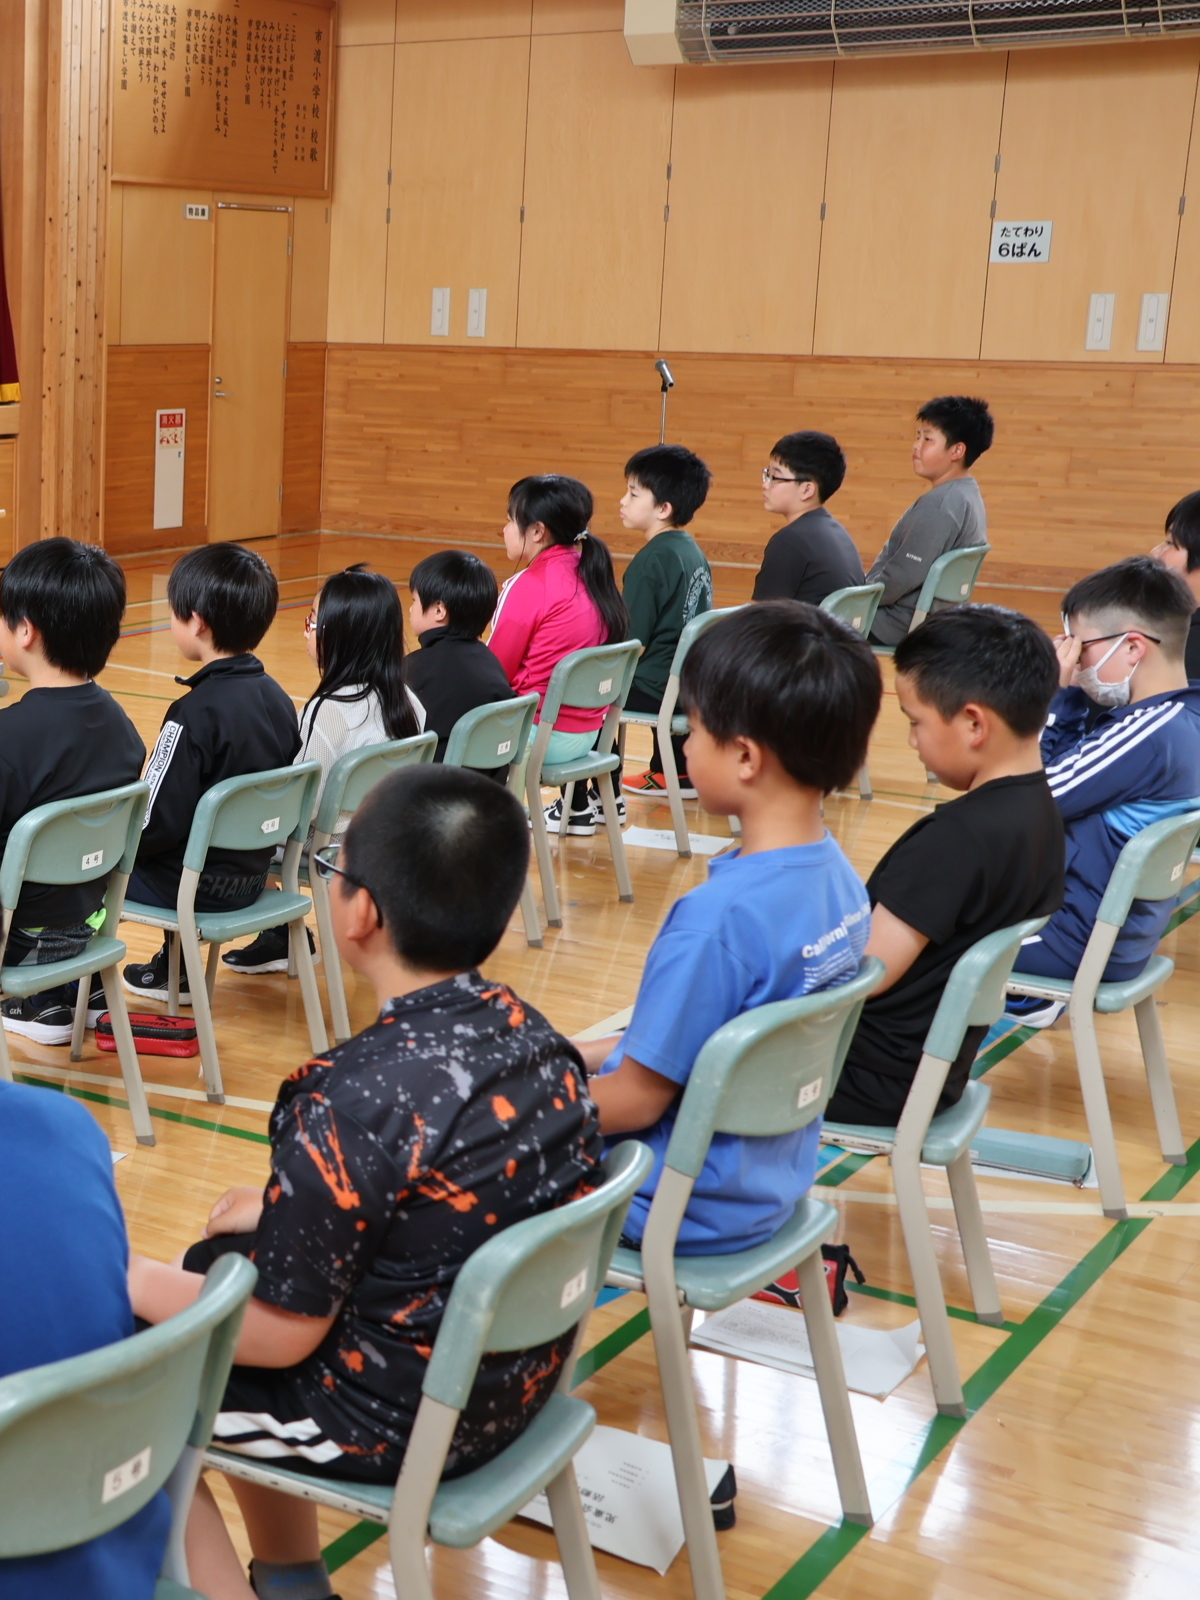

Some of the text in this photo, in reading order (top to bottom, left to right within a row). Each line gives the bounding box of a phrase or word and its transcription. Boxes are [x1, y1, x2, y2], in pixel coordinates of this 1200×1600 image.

[1000, 225, 1044, 238] たてわり
[153, 725, 177, 773] CHAMPION
